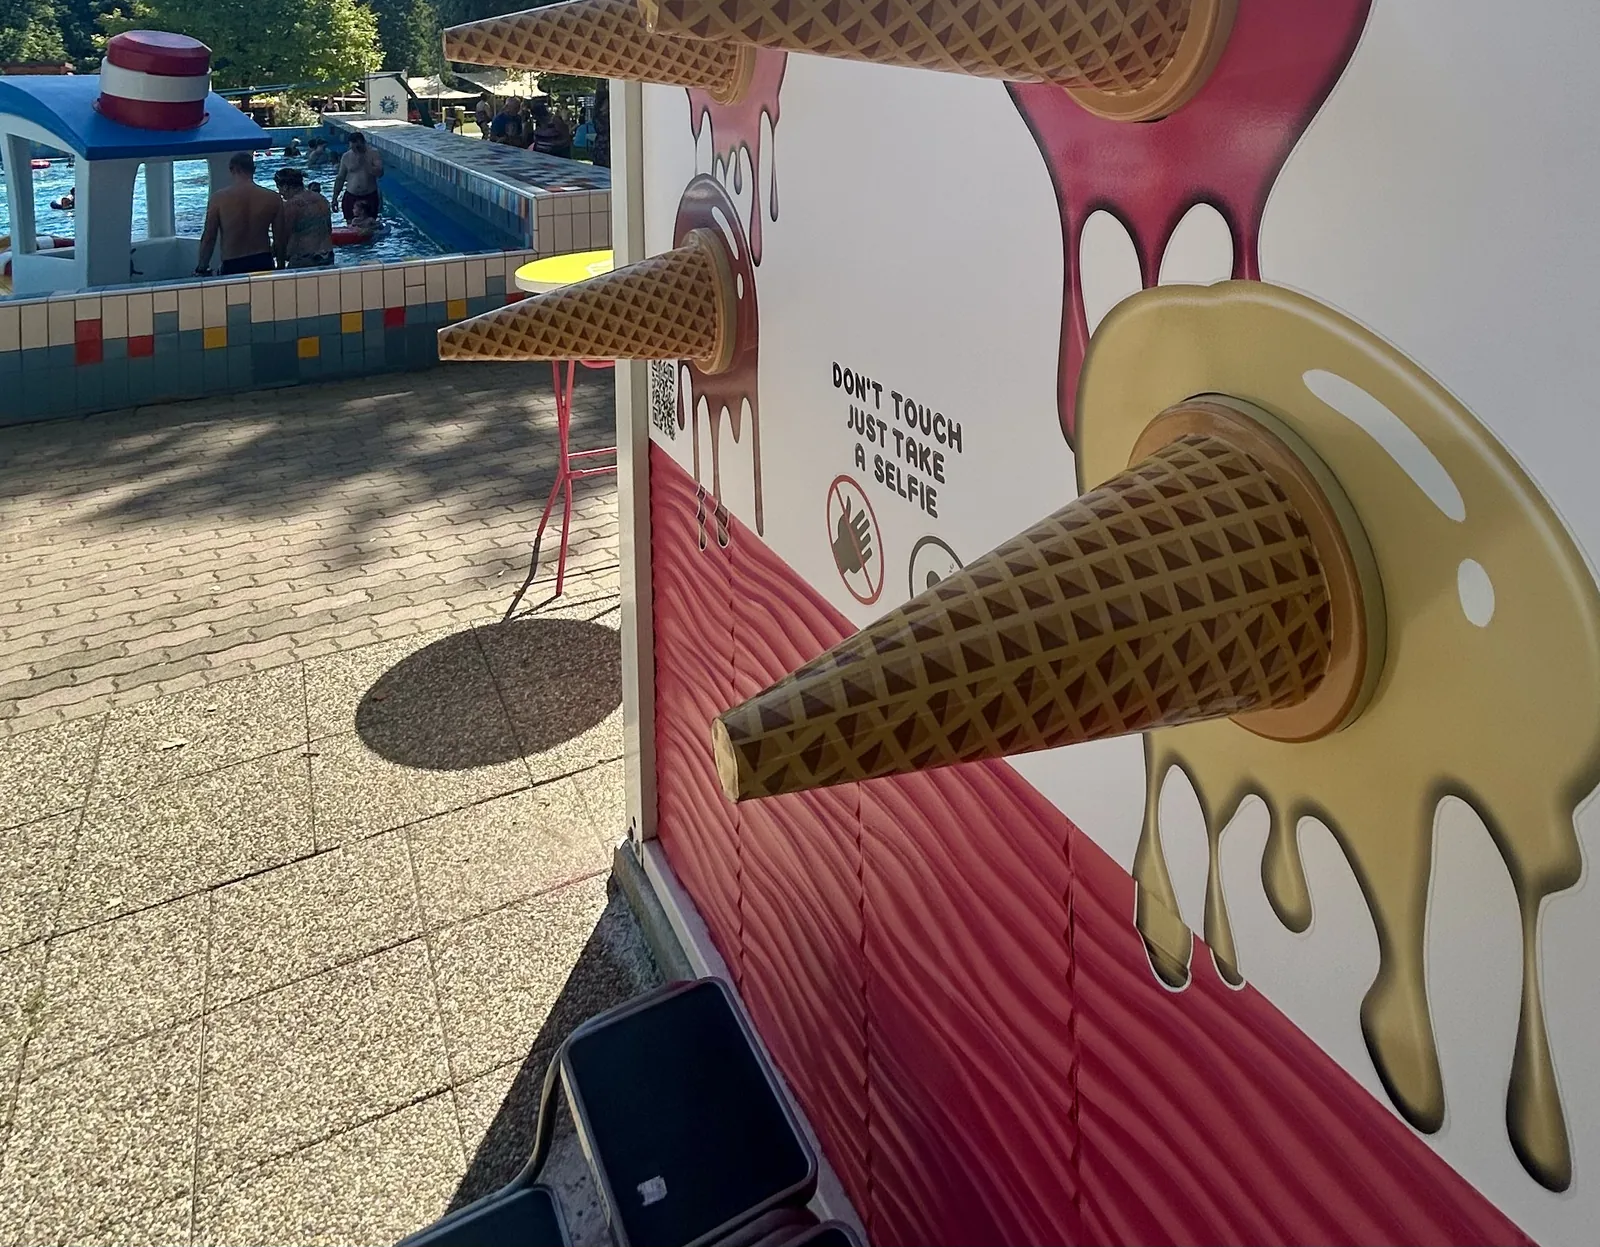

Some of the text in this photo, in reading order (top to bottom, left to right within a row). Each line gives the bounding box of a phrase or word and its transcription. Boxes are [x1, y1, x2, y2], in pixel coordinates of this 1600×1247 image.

[832, 361, 962, 454] DON'T TOUCH
[847, 404, 945, 484] JUST TAKE
[854, 442, 938, 519] A SELFIE
